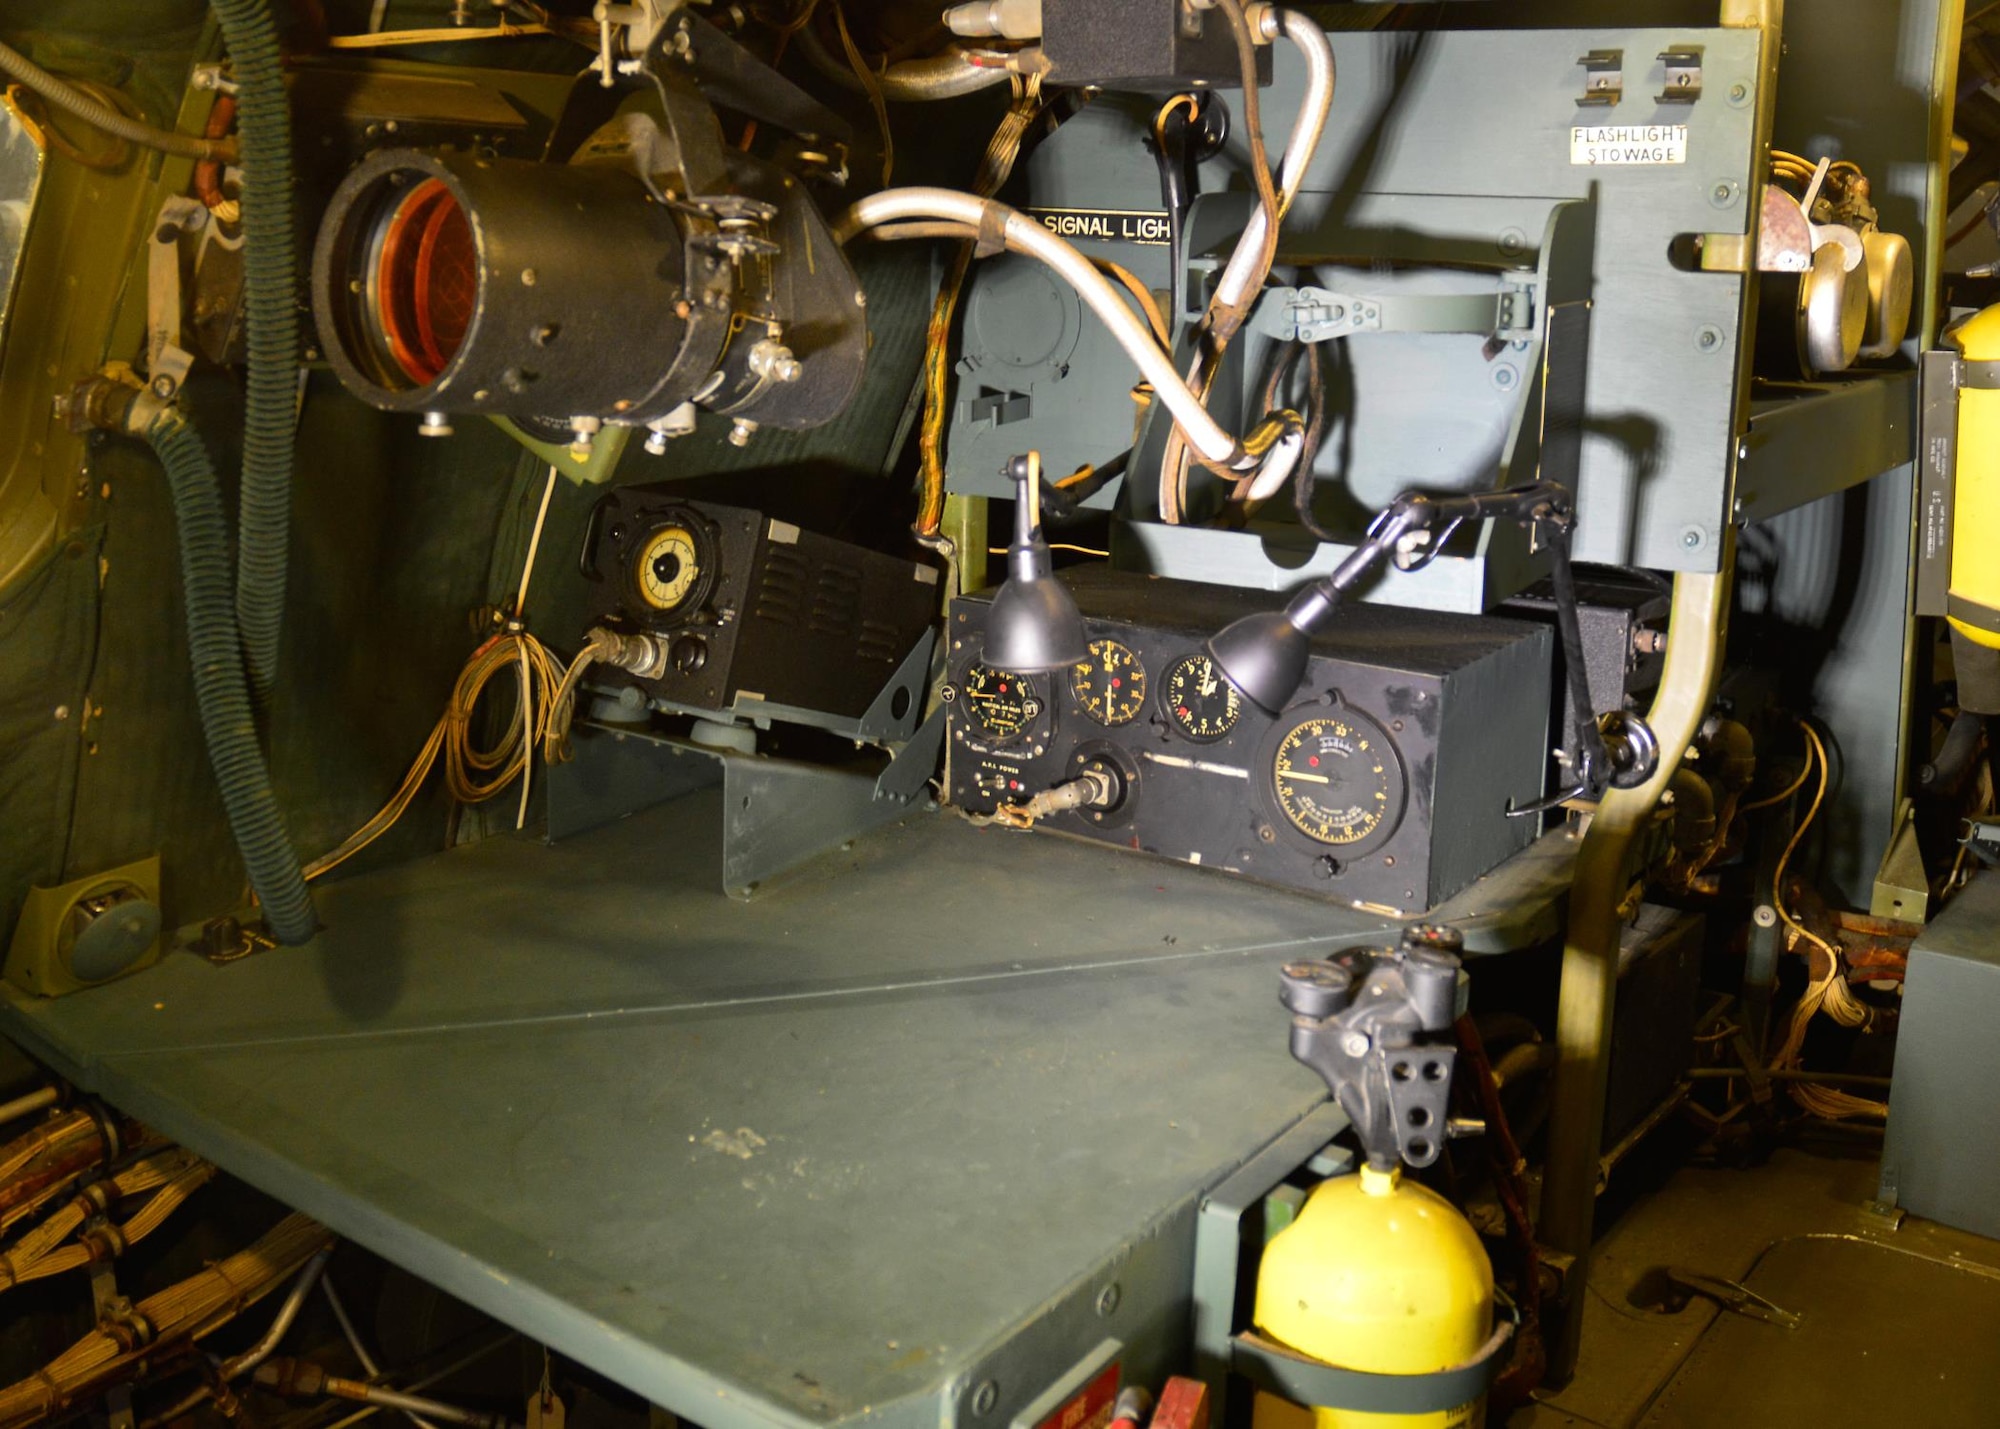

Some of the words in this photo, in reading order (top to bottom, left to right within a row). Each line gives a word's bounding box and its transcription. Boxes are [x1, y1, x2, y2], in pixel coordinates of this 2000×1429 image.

[1574, 126, 1688, 143] FLASHLIGHT
[1587, 147, 1675, 163] STOWAGE
[1044, 215, 1115, 236] SIGNAL
[1122, 218, 1171, 239] LIGH
[1188, 665, 1195, 675] 9
[1177, 677, 1184, 688] 8
[1177, 694, 1184, 705] 7
[1185, 711, 1193, 721] 6
[1226, 707, 1233, 718] 3
[1201, 718, 1208, 730] 5
[1215, 716, 1223, 727] 4
[1311, 726, 1322, 737] 30
[999, 764, 1020, 775] POWER
